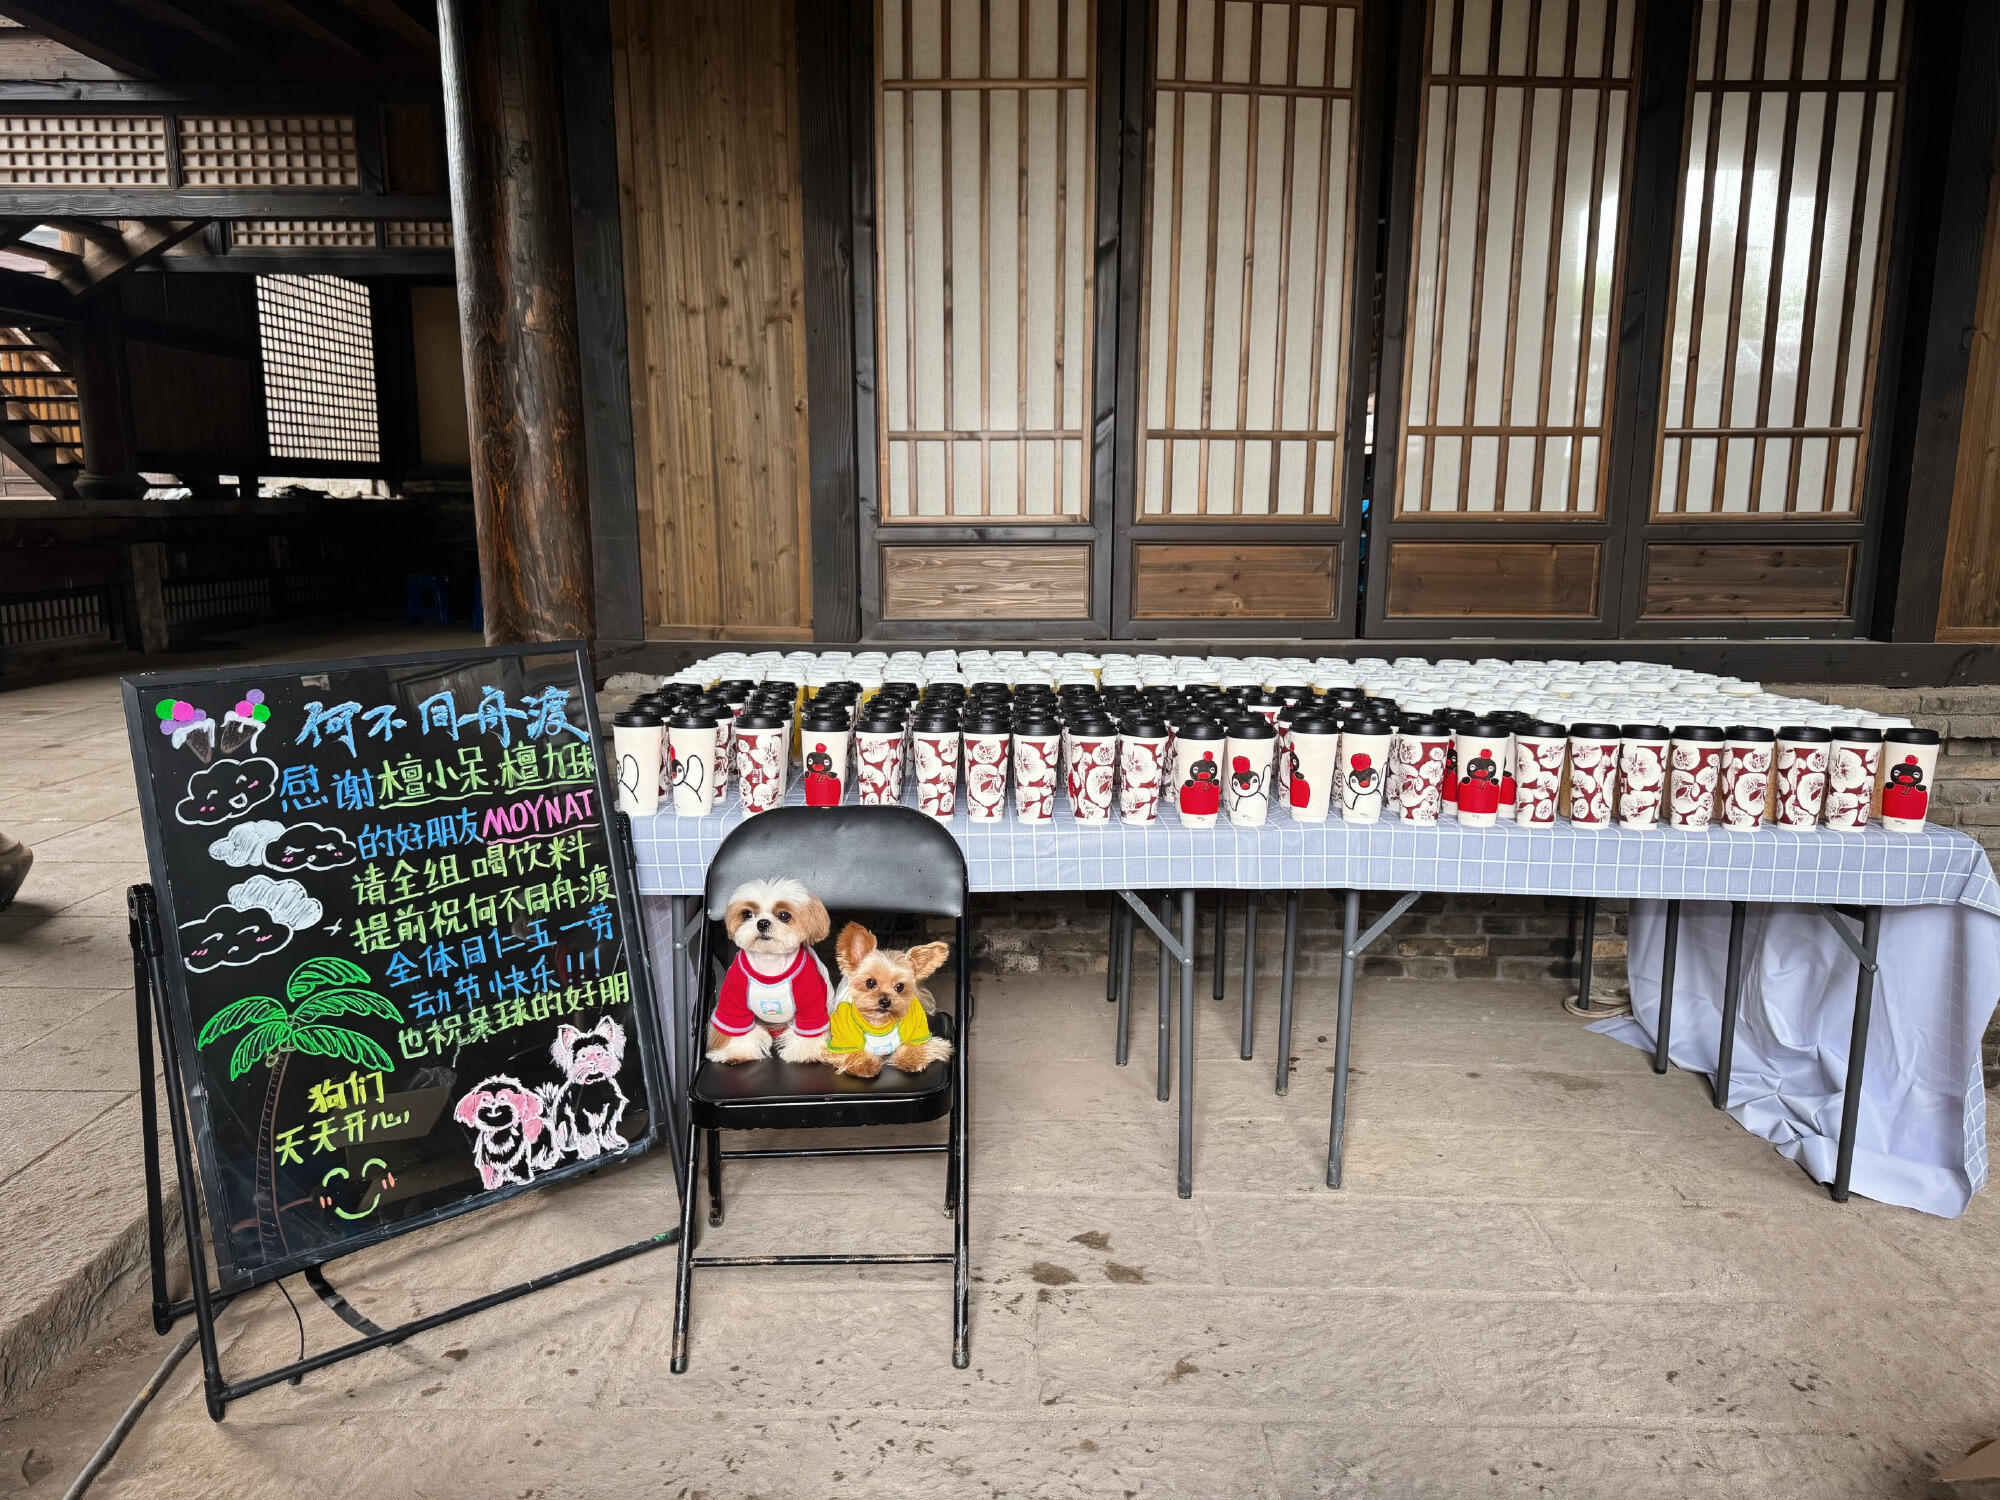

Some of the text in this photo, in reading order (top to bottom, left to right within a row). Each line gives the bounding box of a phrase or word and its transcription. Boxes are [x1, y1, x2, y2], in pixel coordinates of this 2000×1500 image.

[295, 685, 590, 758] 何不同舟渡
[351, 830, 591, 905] 请全组喝饮料
[350, 863, 617, 955] 提前祝何不同舟渡
[385, 903, 614, 988] 全体同仁五一劳
[308, 1070, 385, 1113] 狗们
